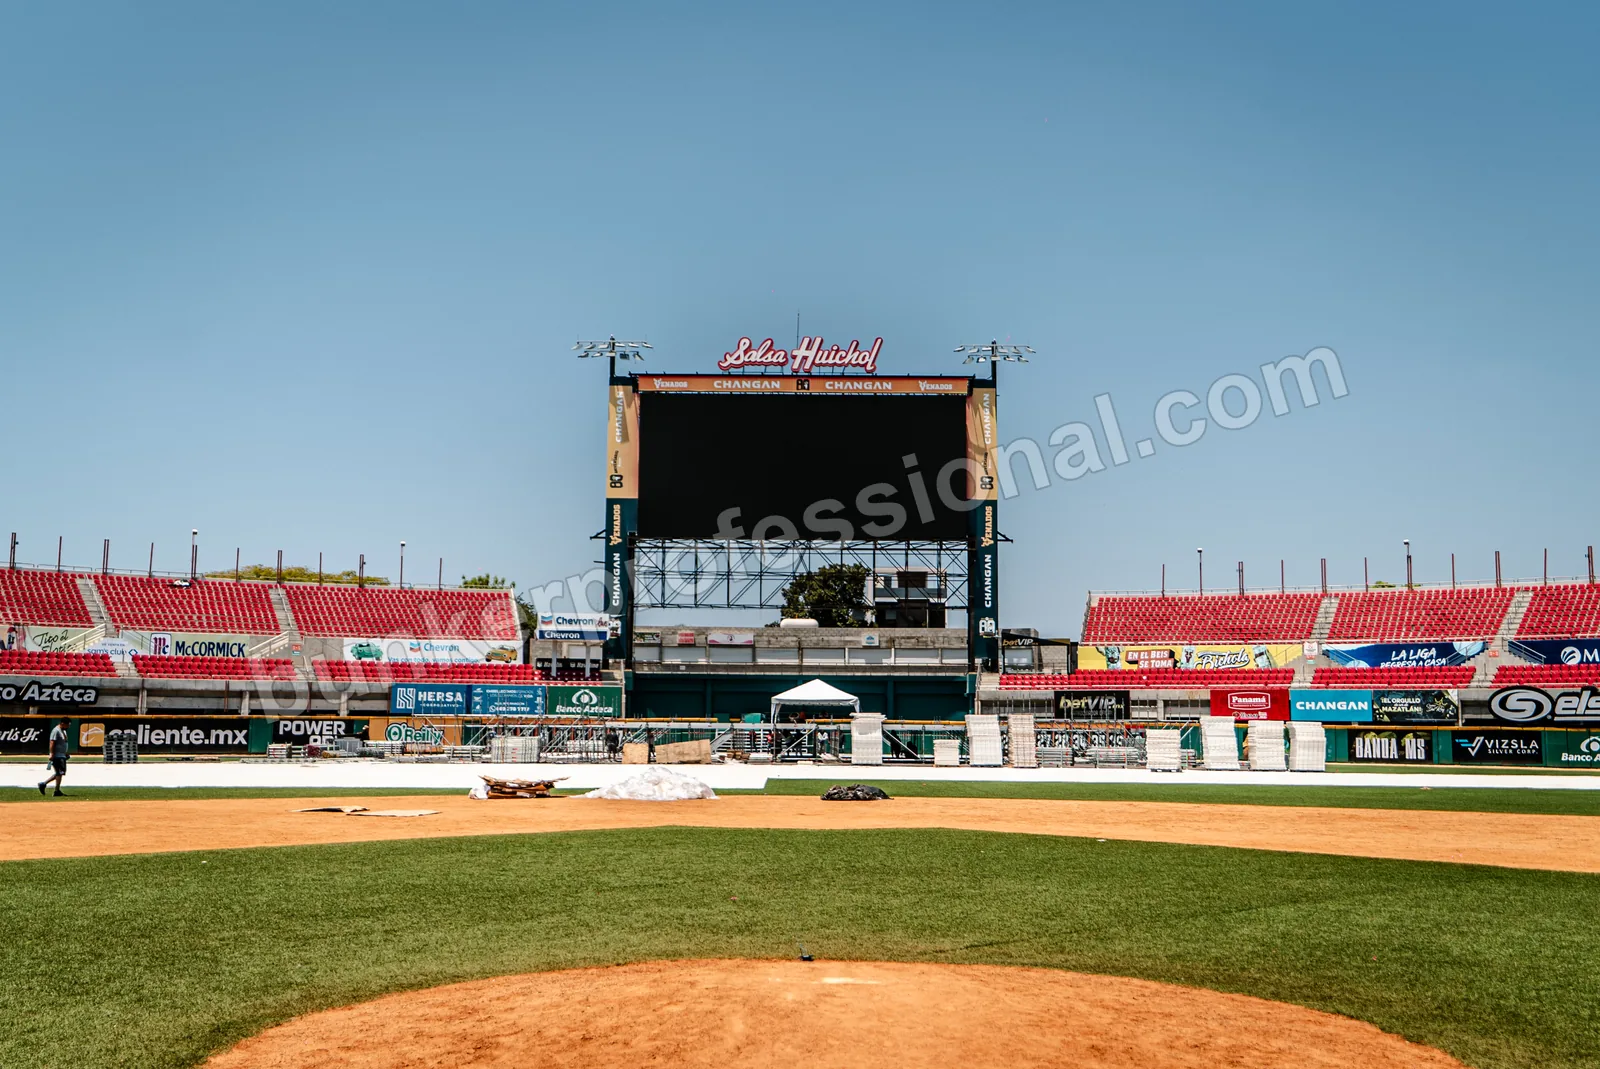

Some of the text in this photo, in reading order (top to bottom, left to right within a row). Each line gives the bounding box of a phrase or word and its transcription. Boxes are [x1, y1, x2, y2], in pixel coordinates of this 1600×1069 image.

[718, 336, 883, 373] Salsa Huichol
[713, 380, 781, 389] CHANGAN
[825, 381, 892, 390] CHANGAN
[615, 391, 624, 443] CHANGAN
[983, 393, 991, 445] CHANGAN
[609, 504, 622, 545] VENADOS
[981, 506, 994, 547] VENADOS
[612, 553, 621, 606] CHANGAN
[984, 554, 992, 608] CHANGAN
[556, 616, 594, 625] Chevron
[544, 630, 580, 639] Chevron
[175, 640, 246, 657] McCORMICK
[423, 642, 460, 651] Chevron
[1128, 650, 1169, 660] EN EL BEIS
[1391, 647, 1437, 661] LA LIGA
[1139, 660, 1173, 668] SE TOMA
[1424, 658, 1447, 667] CASA
[23, 683, 97, 702] Azteca
[418, 691, 463, 702] HERSA
[556, 704, 613, 713] Banco Azteca
[1295, 701, 1369, 710] CHANGAN
[279, 720, 346, 735] POWER
[386, 722, 444, 745] O'Reilly
[0, 728, 20, 741] rl's
[1355, 737, 1425, 760] BANDA MS
[1485, 739, 1539, 749] VIZSLA
[1561, 752, 1593, 762] Banco
